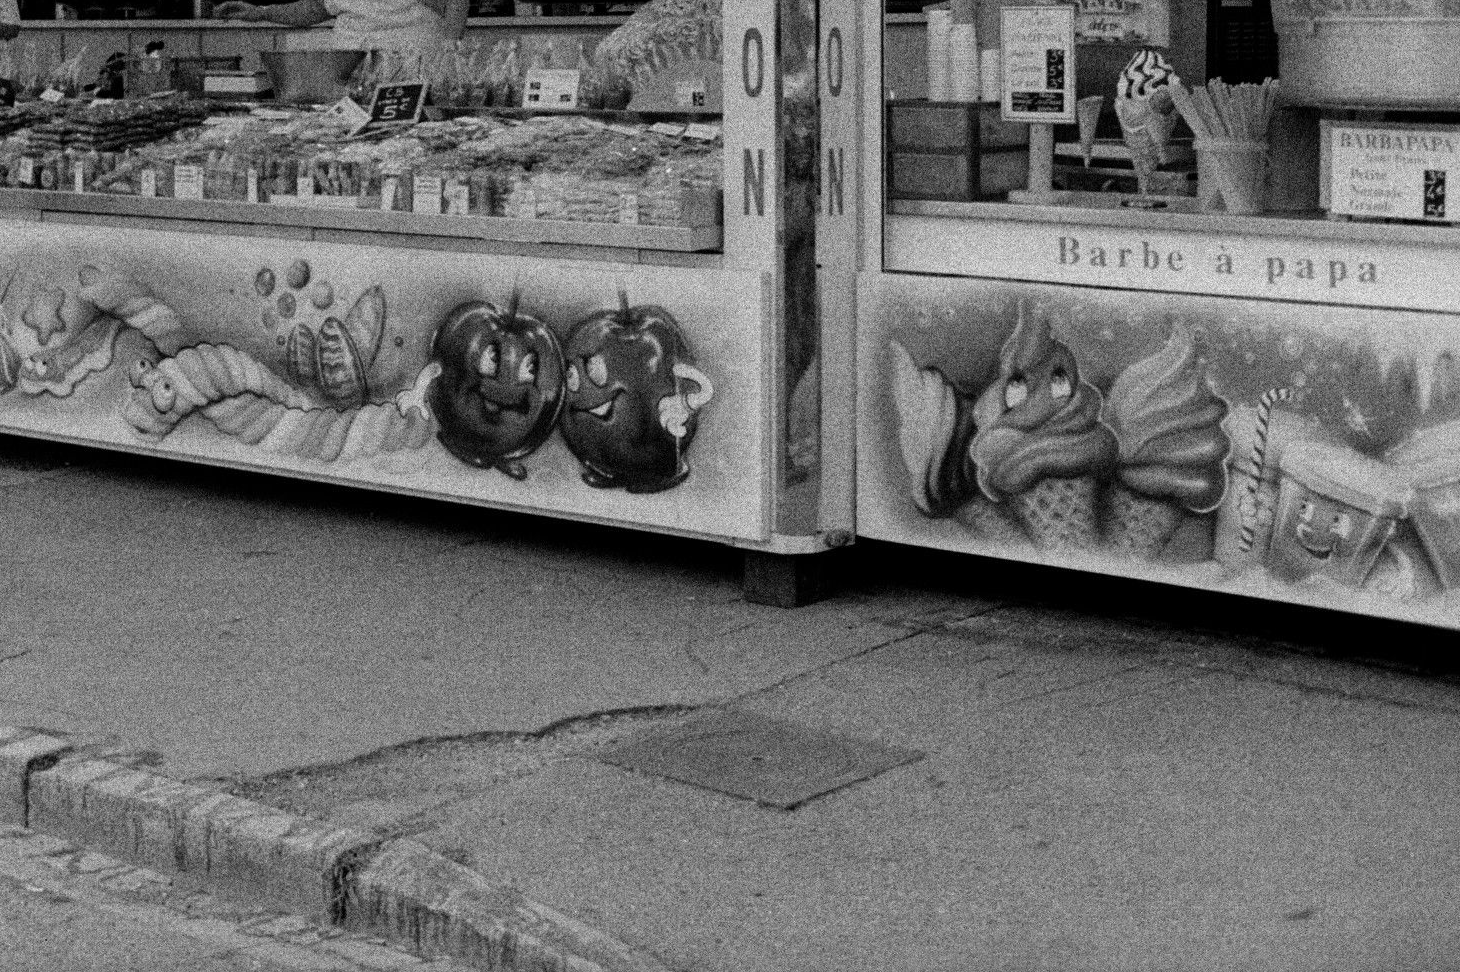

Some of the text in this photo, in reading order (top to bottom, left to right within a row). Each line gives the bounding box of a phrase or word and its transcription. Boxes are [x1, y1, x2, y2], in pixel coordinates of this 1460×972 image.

[1340, 131, 1456, 154] BARBAPAPA
[1058, 236, 1381, 289] Barbe à papa
